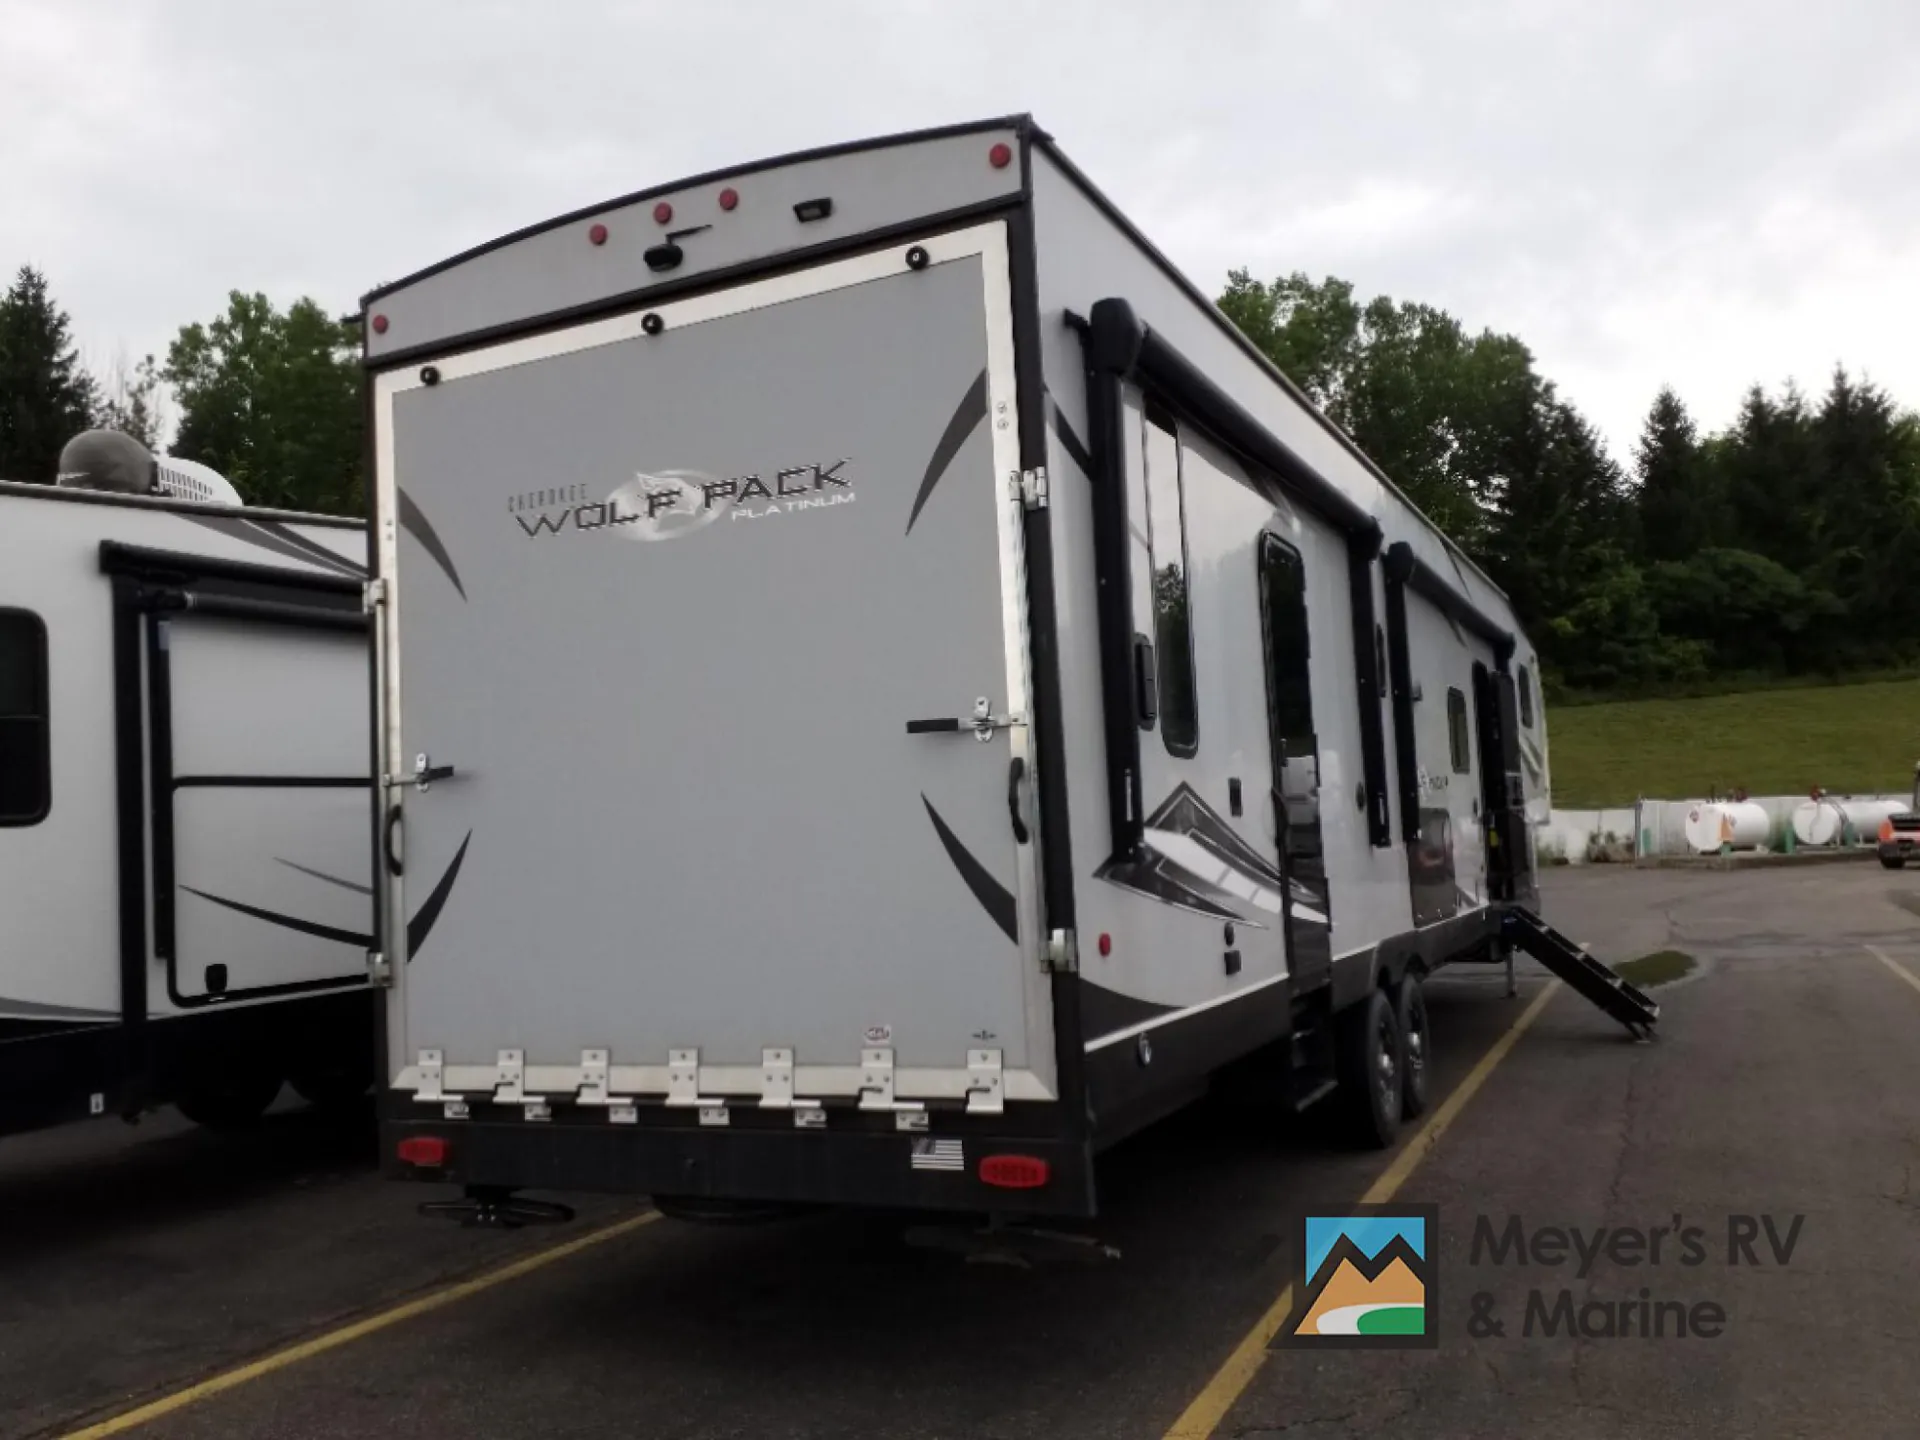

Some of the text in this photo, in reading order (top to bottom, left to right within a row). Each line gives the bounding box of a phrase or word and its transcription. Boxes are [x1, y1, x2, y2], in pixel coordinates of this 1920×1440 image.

[516, 457, 852, 538] WOLF PACK
[731, 492, 856, 521] PLATINUM
